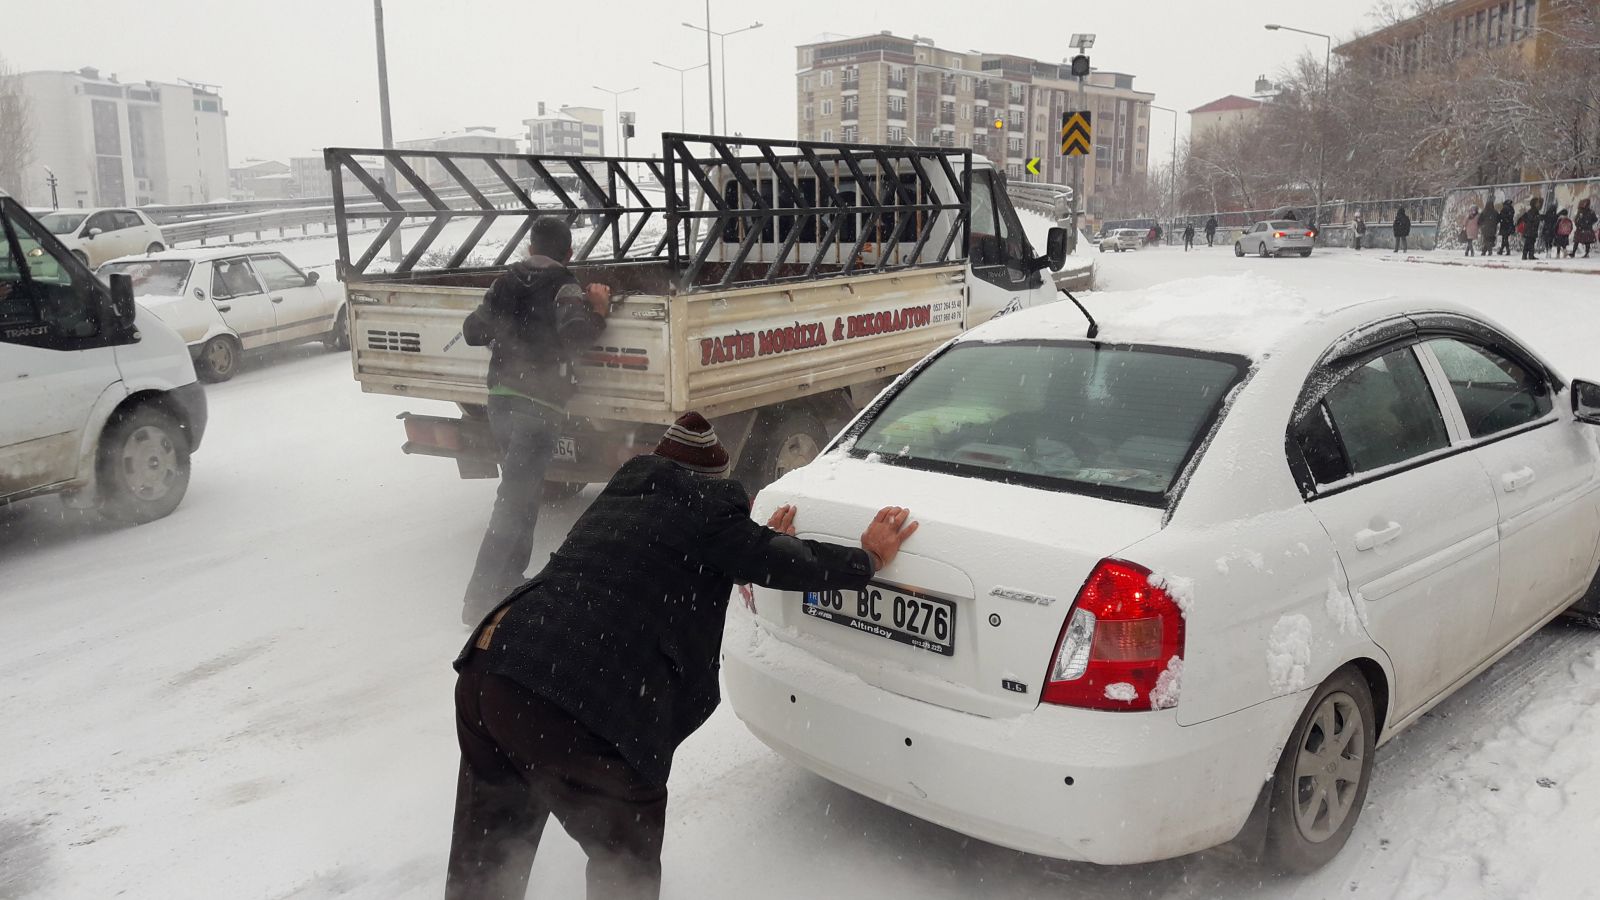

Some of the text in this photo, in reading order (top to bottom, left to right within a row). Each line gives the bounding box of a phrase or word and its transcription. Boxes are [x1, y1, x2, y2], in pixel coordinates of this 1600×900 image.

[758, 320, 827, 356] MOBİLYA
[832, 316, 844, 341] &
[847, 304, 931, 338] DEKORASYON
[857, 587, 882, 621] BC
[893, 596, 948, 640] 0276
[1006, 681, 1022, 692] 1.6
